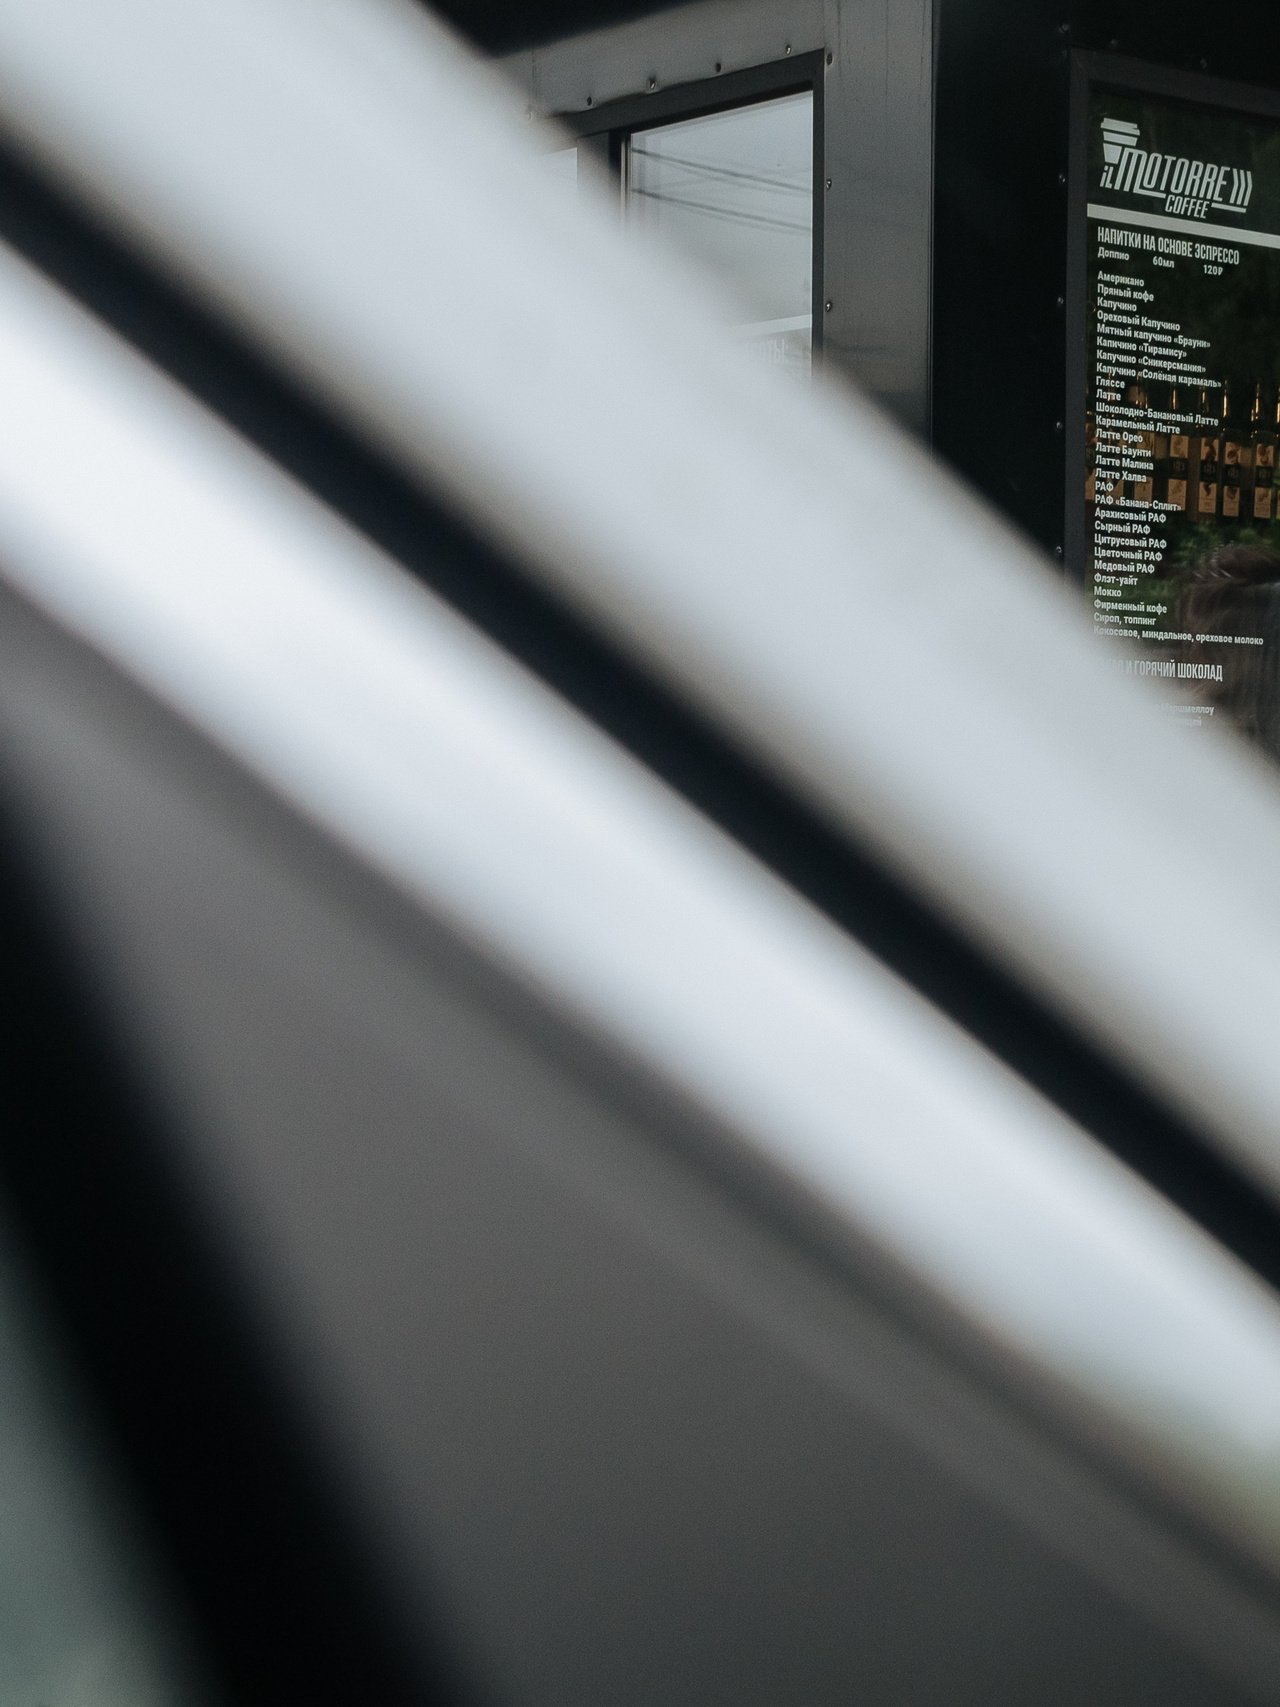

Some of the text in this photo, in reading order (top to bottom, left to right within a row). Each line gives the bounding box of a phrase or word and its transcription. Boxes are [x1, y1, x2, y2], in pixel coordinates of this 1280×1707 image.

[1114, 147, 1230, 202] MOTORRE
[1165, 194, 1210, 219] COFFEE
[1098, 226, 1240, 265] НАПИТКИ НА ОСНОВЕ ЭСПРЕССО
[1098, 247, 1223, 276] Доппио 60мл 120₽
[1098, 270, 1144, 286] Американо
[1098, 284, 1154, 302] Пряный кофе
[1098, 296, 1137, 312] Капучино
[1098, 310, 1180, 332] Ореховый Капучино
[1097, 324, 1210, 348] Мятный капучино «Брауни»
[1138, 343, 1187, 359] «Тирамису»
[1096, 350, 1206, 373] Капучино «Сникерсмания»
[1096, 362, 1136, 376] Капучино
[1138, 368, 1176, 382] «Солёная
[1096, 376, 1126, 388] Гляссе
[1096, 389, 1122, 400] Латте
[1096, 416, 1180, 434] Карамельный Латте
[1195, 415, 1218, 426] Латте
[1096, 428, 1144, 443] Латте Орео
[1096, 442, 1152, 459] Латте Баунти
[1096, 455, 1154, 470] Латте Малина
[1096, 468, 1146, 482] Латте Халва
[1095, 481, 1114, 492] РАФ
[1095, 494, 1114, 506] РАФ
[1094, 507, 1166, 524] Арахисовый РАФ
[1094, 520, 1150, 534] Сырный РАФ
[1094, 534, 1167, 549] Цитрусовый РАФ
[1094, 546, 1162, 561] Цветочный РАФ
[1094, 560, 1154, 574] Медовый РАФ
[1094, 572, 1138, 587] Флэт-уайт
[1094, 586, 1122, 597] Мокко
[1094, 598, 1167, 615] Фирменный кофе
[1094, 612, 1156, 625] Сироп, топпинг
[1142, 630, 1194, 642] миндальное,
[1196, 634, 1232, 644] ореховое
[1234, 636, 1264, 646] молоко
[1134, 659, 1176, 678] ГОРЯЧИЙ
[1178, 662, 1223, 682] ШОКОЛАД
